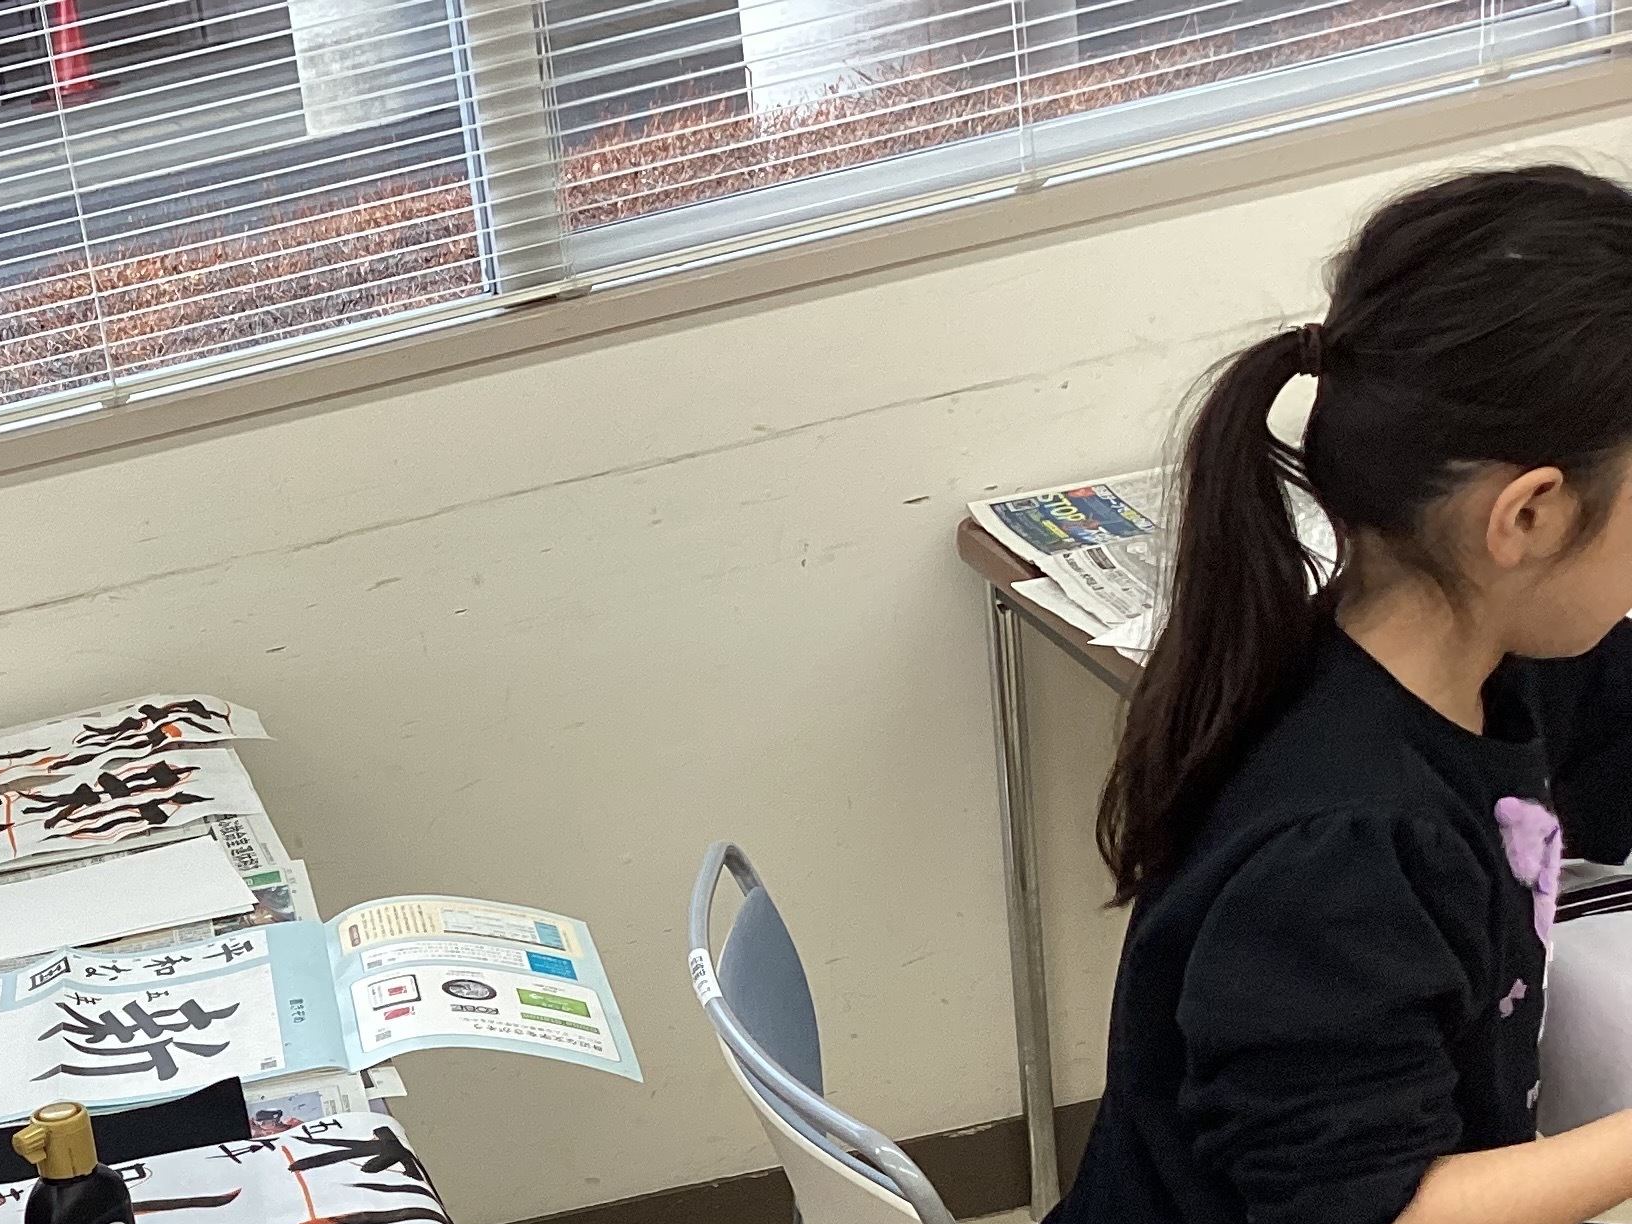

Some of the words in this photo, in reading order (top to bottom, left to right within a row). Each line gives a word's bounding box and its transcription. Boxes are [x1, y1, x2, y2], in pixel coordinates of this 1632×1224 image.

[25, 936, 258, 993] 平和な国
[62, 990, 168, 1008] 五年
